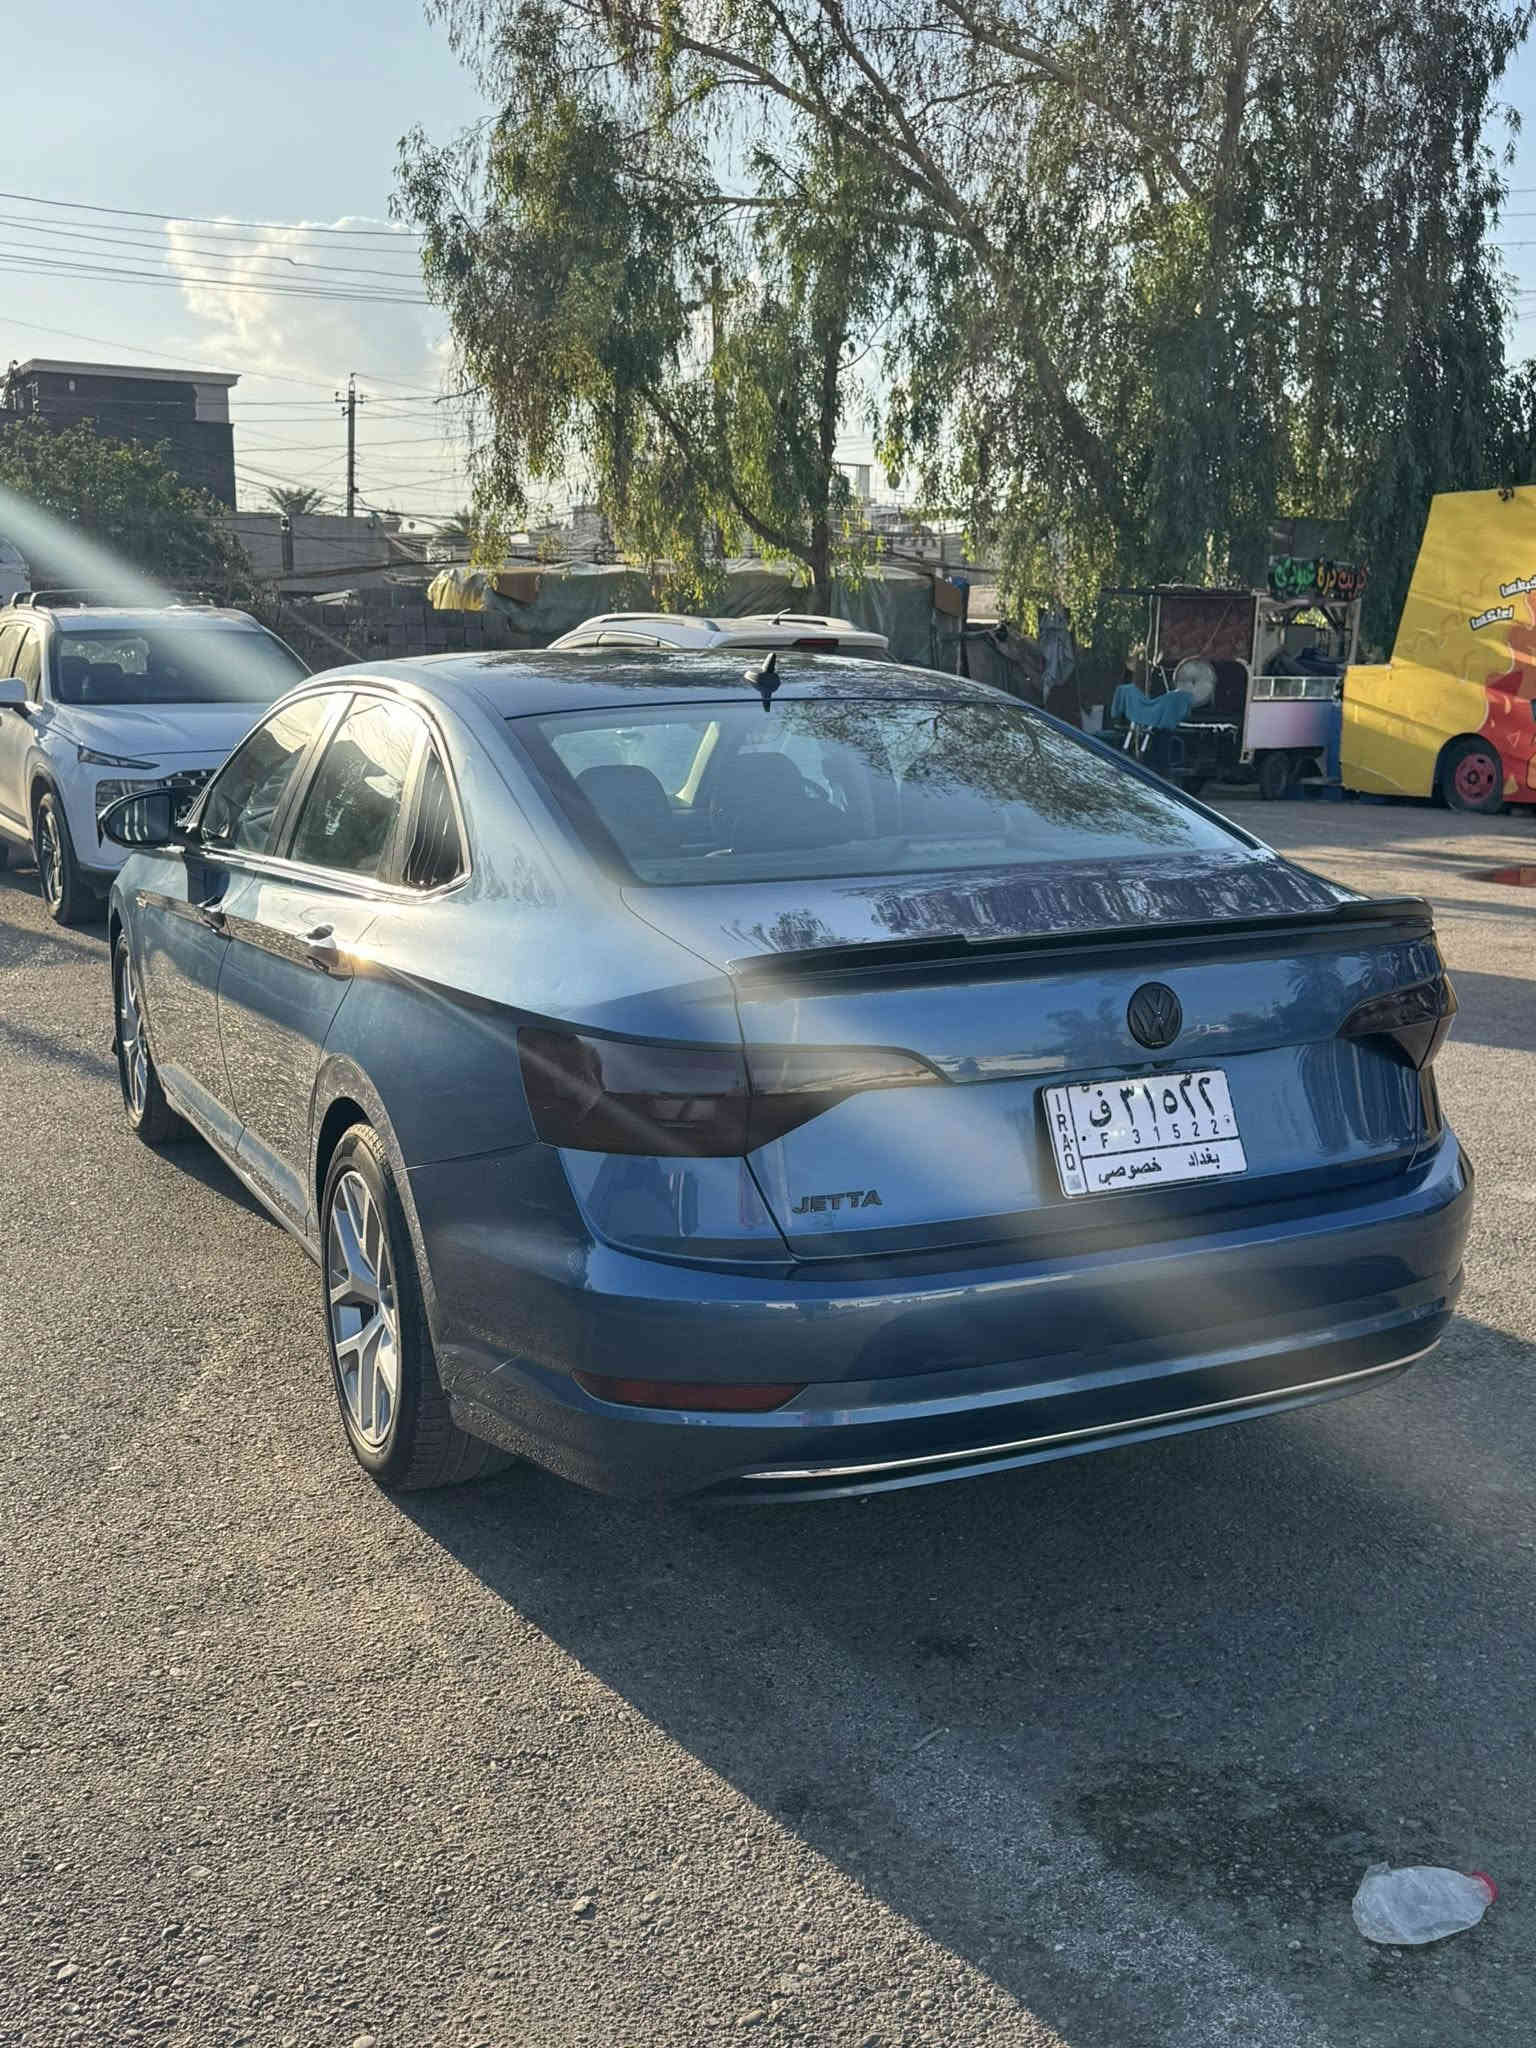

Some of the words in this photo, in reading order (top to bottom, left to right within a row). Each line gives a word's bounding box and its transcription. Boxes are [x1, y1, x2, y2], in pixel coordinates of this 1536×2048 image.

[1054, 1093, 1077, 1171] IRAQ
[1098, 1156, 1163, 1186] خصوصي
[1187, 1147, 1221, 1170] بغداد
[791, 1189, 883, 1214] JETTA
